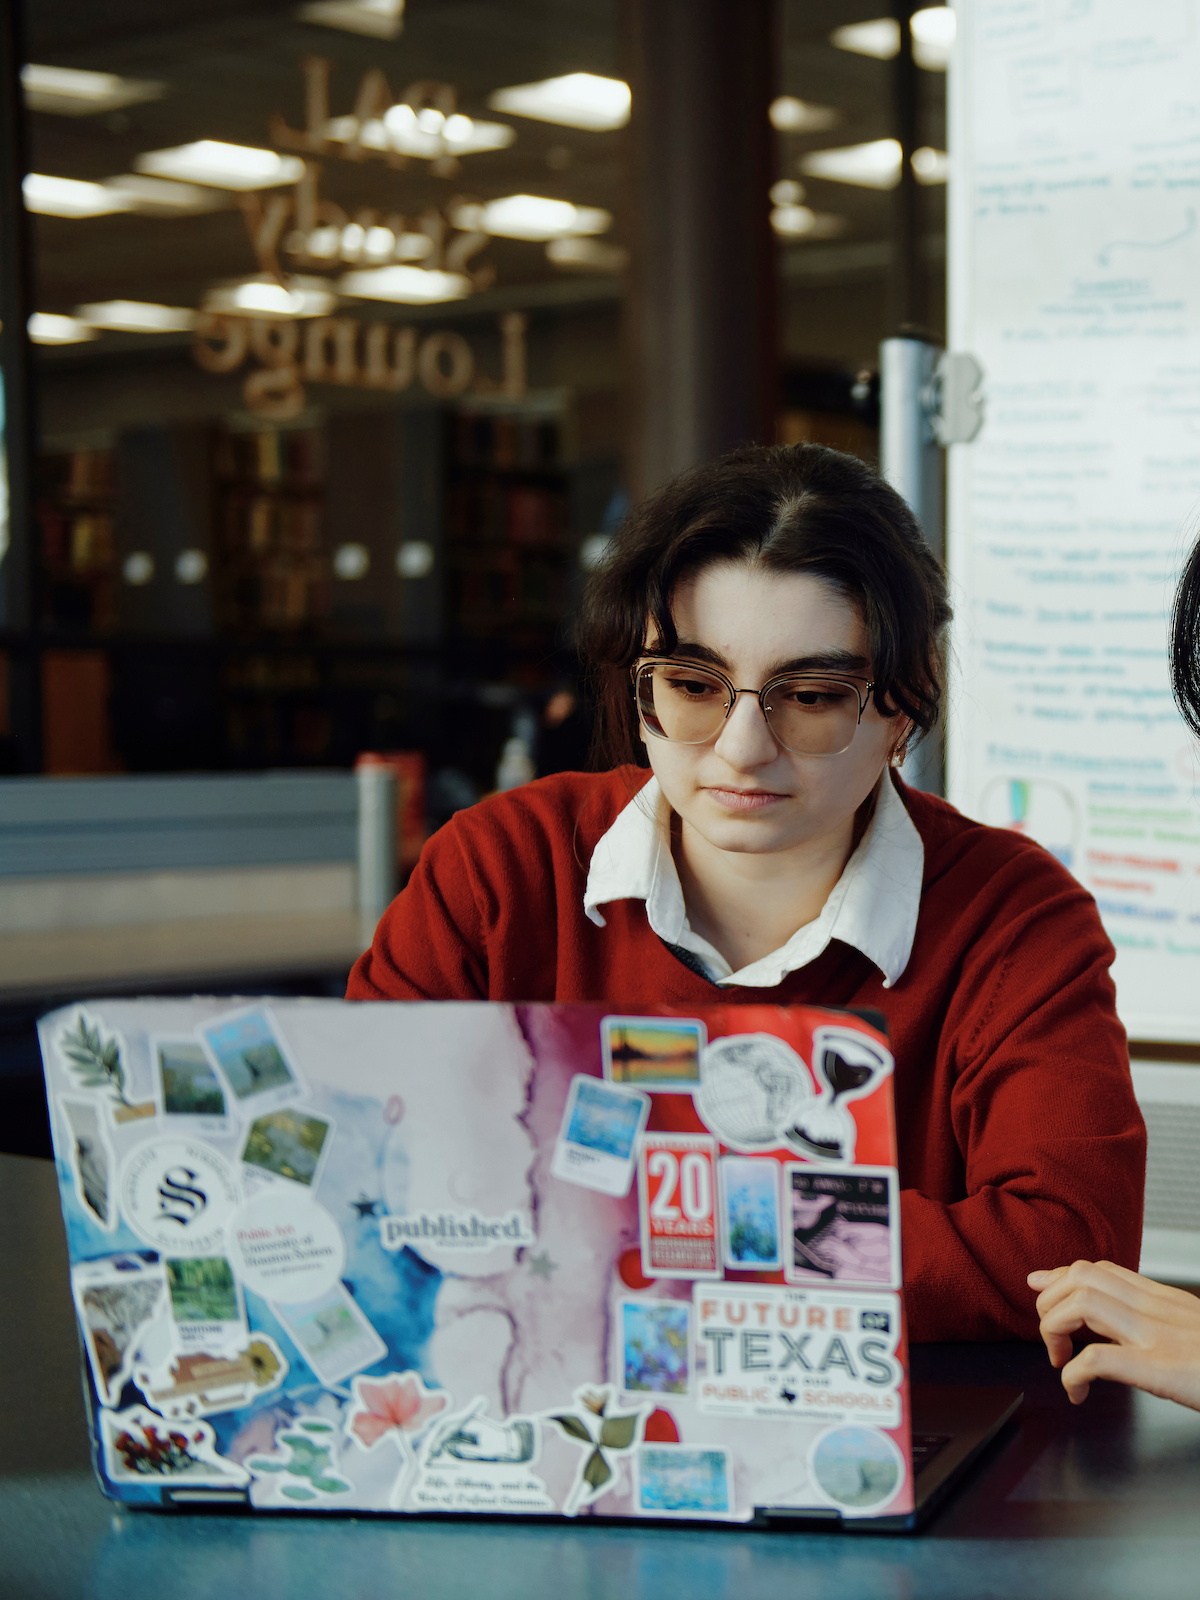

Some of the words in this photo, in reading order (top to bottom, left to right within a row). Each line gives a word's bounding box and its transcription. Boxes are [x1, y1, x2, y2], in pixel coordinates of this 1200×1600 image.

[648, 1151, 712, 1220] 20
[652, 1218, 713, 1236] YEARS
[702, 1300, 853, 1332] FUTURE
[862, 1312, 890, 1332] OF
[703, 1327, 895, 1388] TEXAS
[703, 1383, 771, 1403] PUBLIC
[803, 1389, 896, 1411] SCHOOLS
